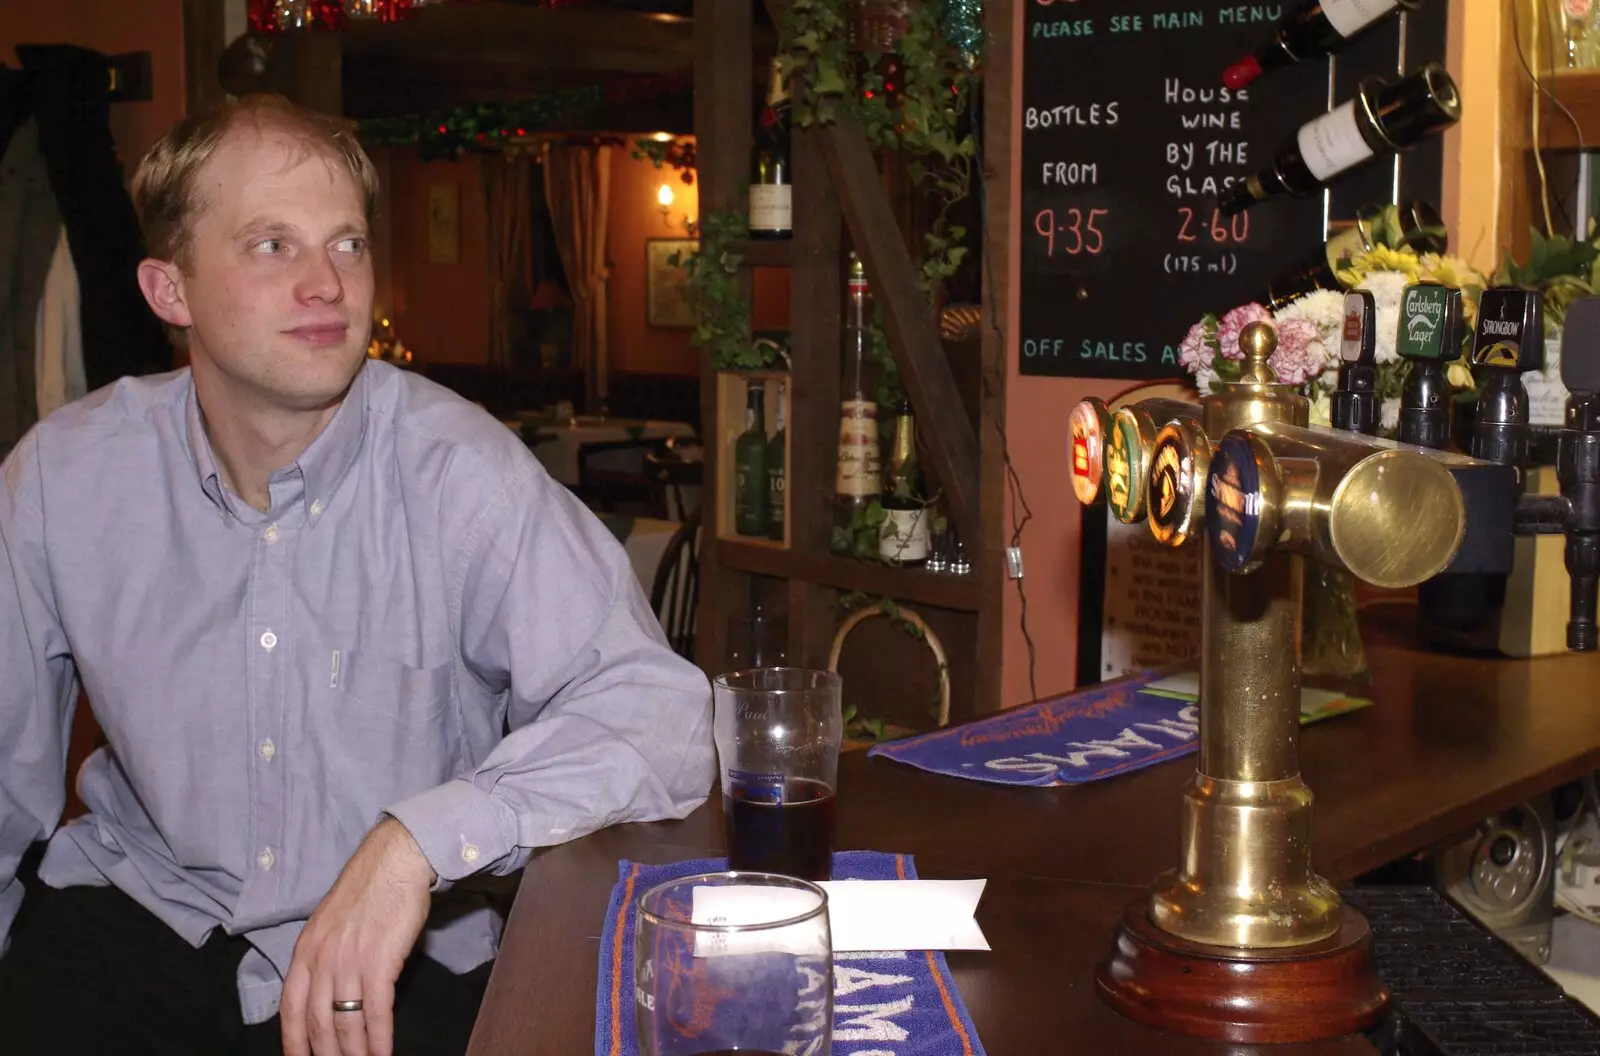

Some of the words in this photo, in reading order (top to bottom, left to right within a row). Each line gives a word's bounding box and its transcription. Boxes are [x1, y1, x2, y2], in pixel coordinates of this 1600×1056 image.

[1032, 20, 1094, 38] PLEASE
[1108, 16, 1143, 33] SEE
[1152, 12, 1204, 30] MAIN
[1218, 5, 1282, 25] MENU
[1024, 102, 1120, 129] BOTTLES
[1180, 111, 1242, 129] WINE
[1204, 140, 1249, 166] THE
[1041, 161, 1098, 186] FROM
[1165, 174, 1246, 198] GLAS
[1406, 290, 1442, 322] Carlsberg
[1408, 328, 1434, 350] Lager
[1481, 318, 1520, 336] STRONGBOW
[1023, 339, 1065, 358] OFF
[1079, 339, 1148, 363] SALES
